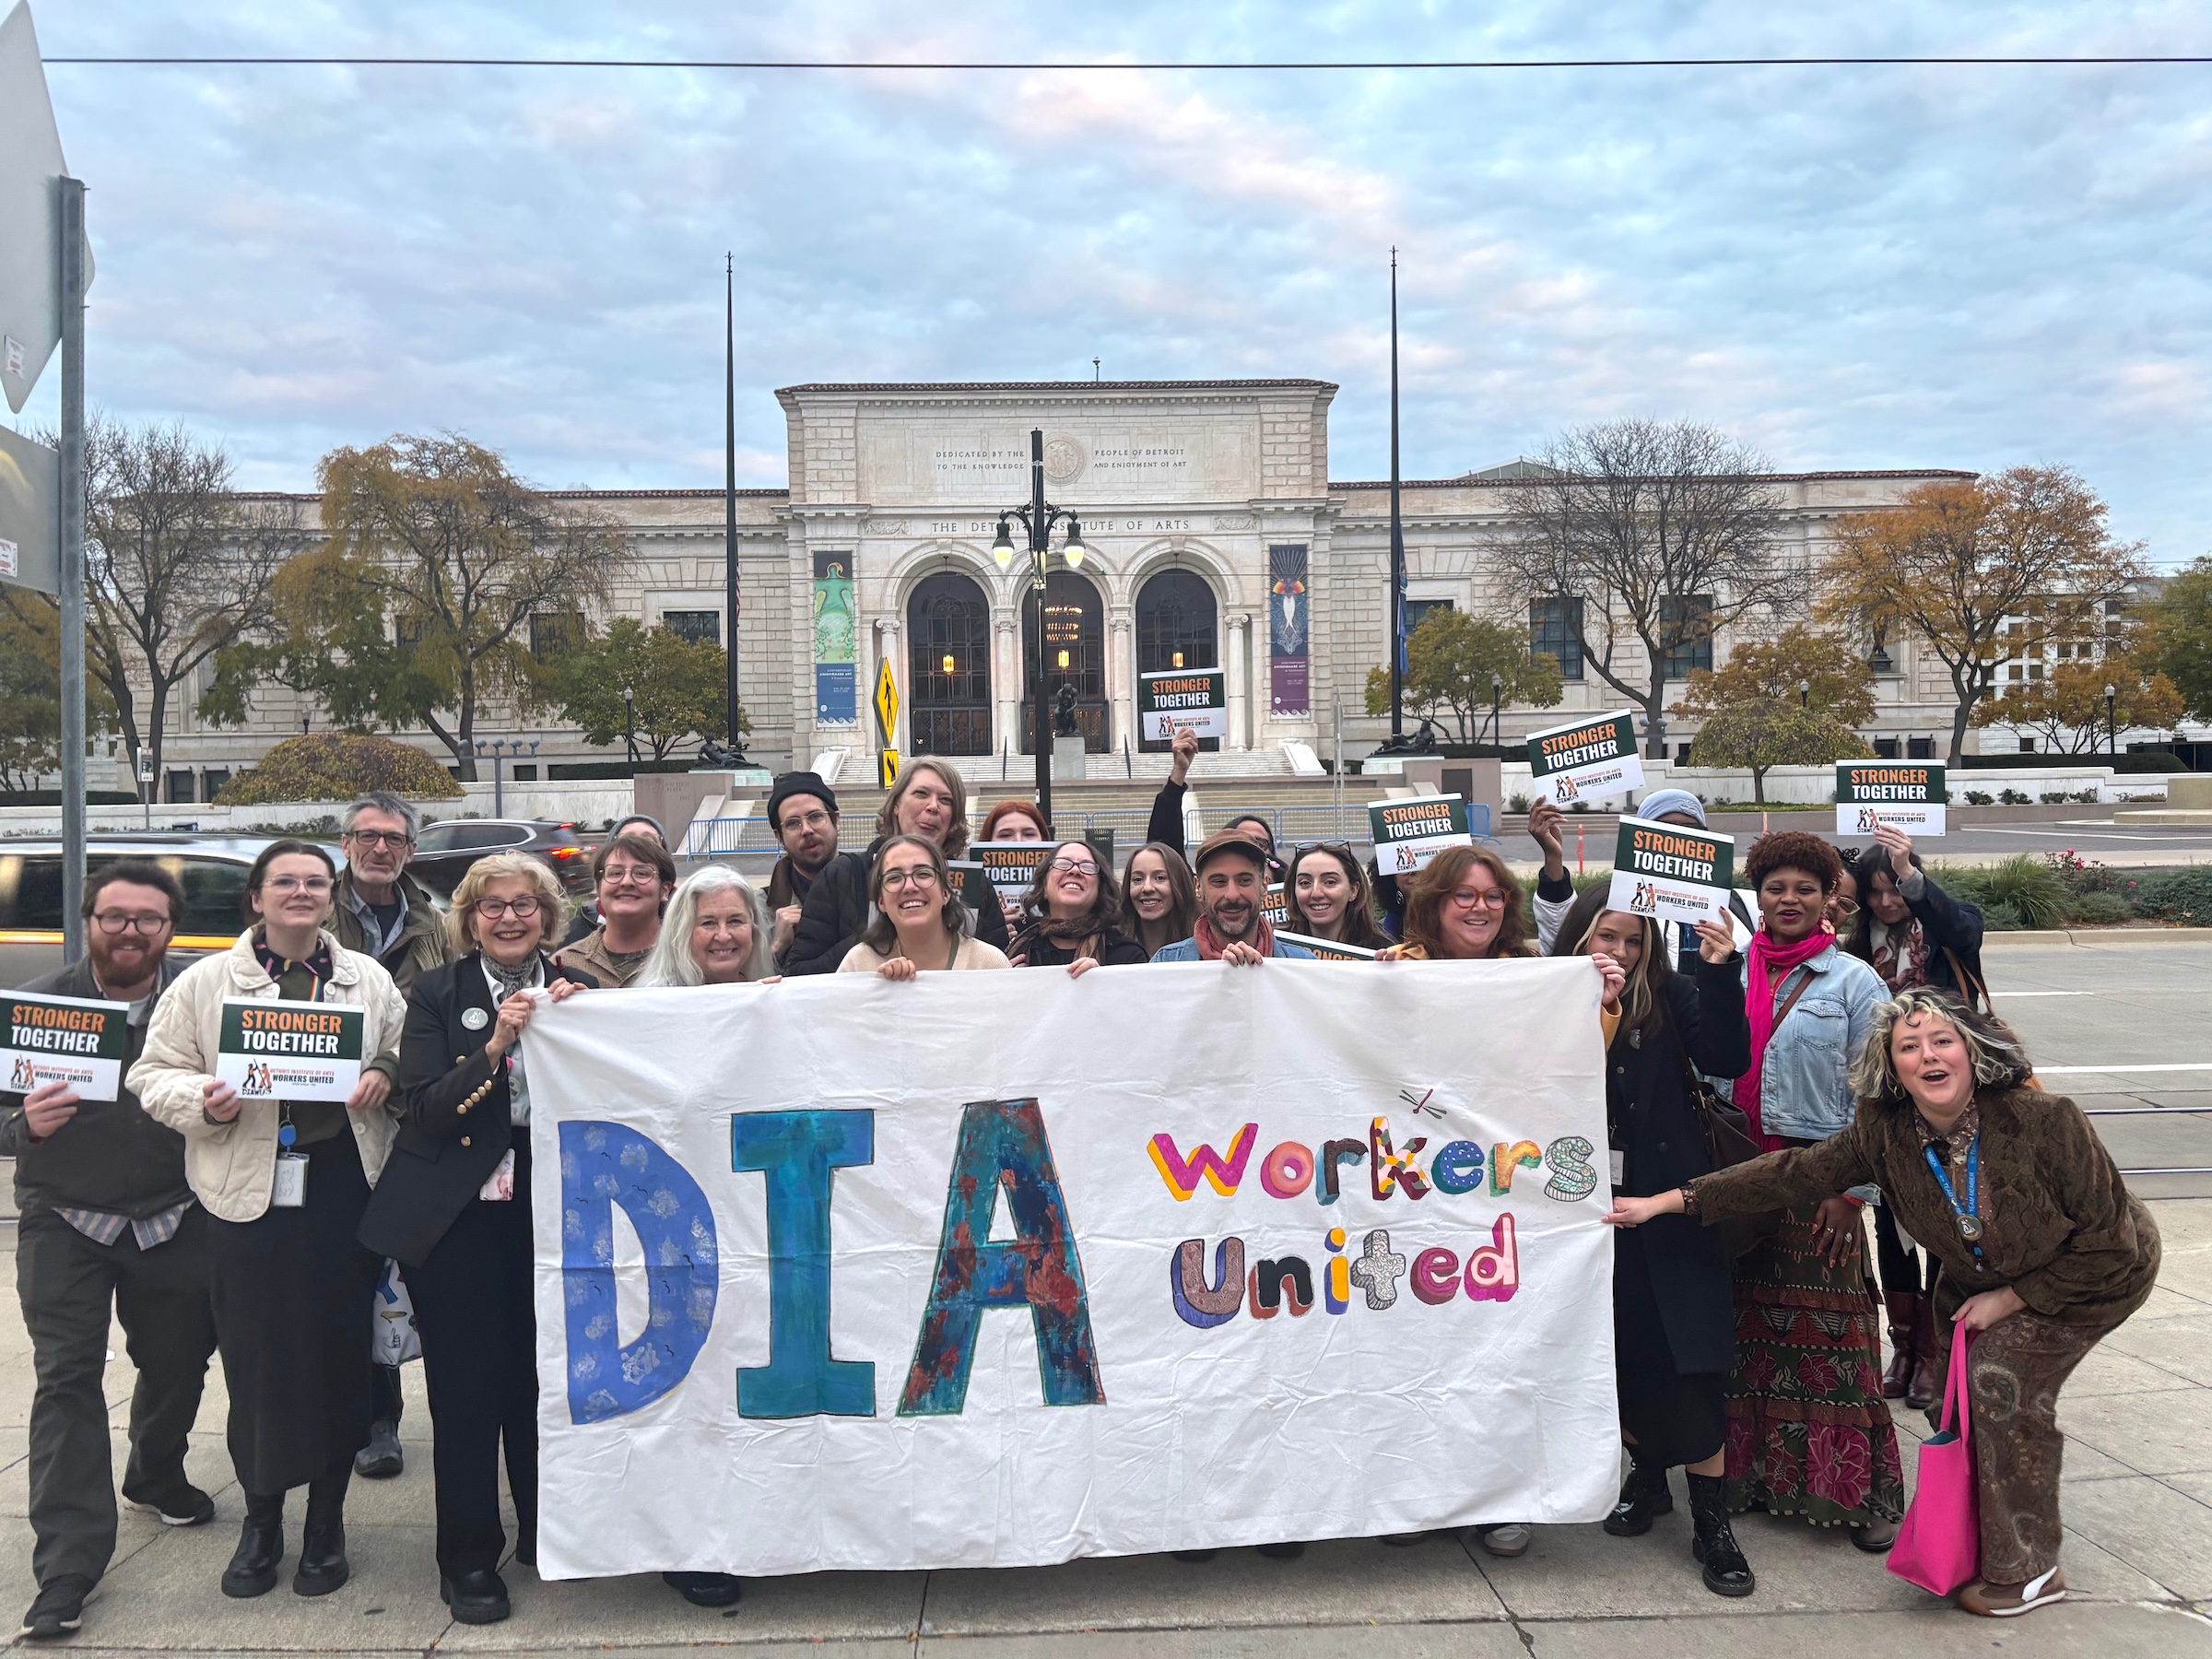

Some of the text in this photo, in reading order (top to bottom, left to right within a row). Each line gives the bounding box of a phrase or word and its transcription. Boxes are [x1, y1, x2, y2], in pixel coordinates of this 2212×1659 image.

[932, 523, 958, 533] THE
[1126, 521, 1143, 530] OF
[1155, 520, 1189, 530] ARTS
[1152, 677, 1210, 694] STRONGER
[1153, 691, 1210, 709] TOGETHER
[1542, 724, 1617, 755] STRONGER
[1545, 739, 1619, 771] TOGETHER
[1575, 776, 1602, 788] WORKERS
[1603, 772, 1623, 782] UNITED
[1851, 769, 1928, 784] STRONGER
[1852, 784, 1927, 800] TOGETHER
[1382, 804, 1451, 824] STRONGER
[1385, 818, 1453, 839] TOGETHER
[1633, 830, 1716, 862] STRONGER
[1633, 850, 1713, 881] TOGETHER
[1656, 894, 1686, 906] WORKERS
[1687, 900, 1709, 910] UNITED
[11, 1004, 106, 1032] STRONGER
[241, 1009, 343, 1033] STRONGER
[11, 1025, 100, 1053] TOGETHER
[241, 1030, 339, 1054] TOGETHER
[35, 1070, 66, 1080] WORKERS
[67, 1074, 93, 1083] UNITED
[273, 1074, 308, 1083] WORKERS
[309, 1076, 335, 1085] UNITED
[558, 1097, 1107, 1426] DIA
[1171, 1212, 1520, 1329] United
